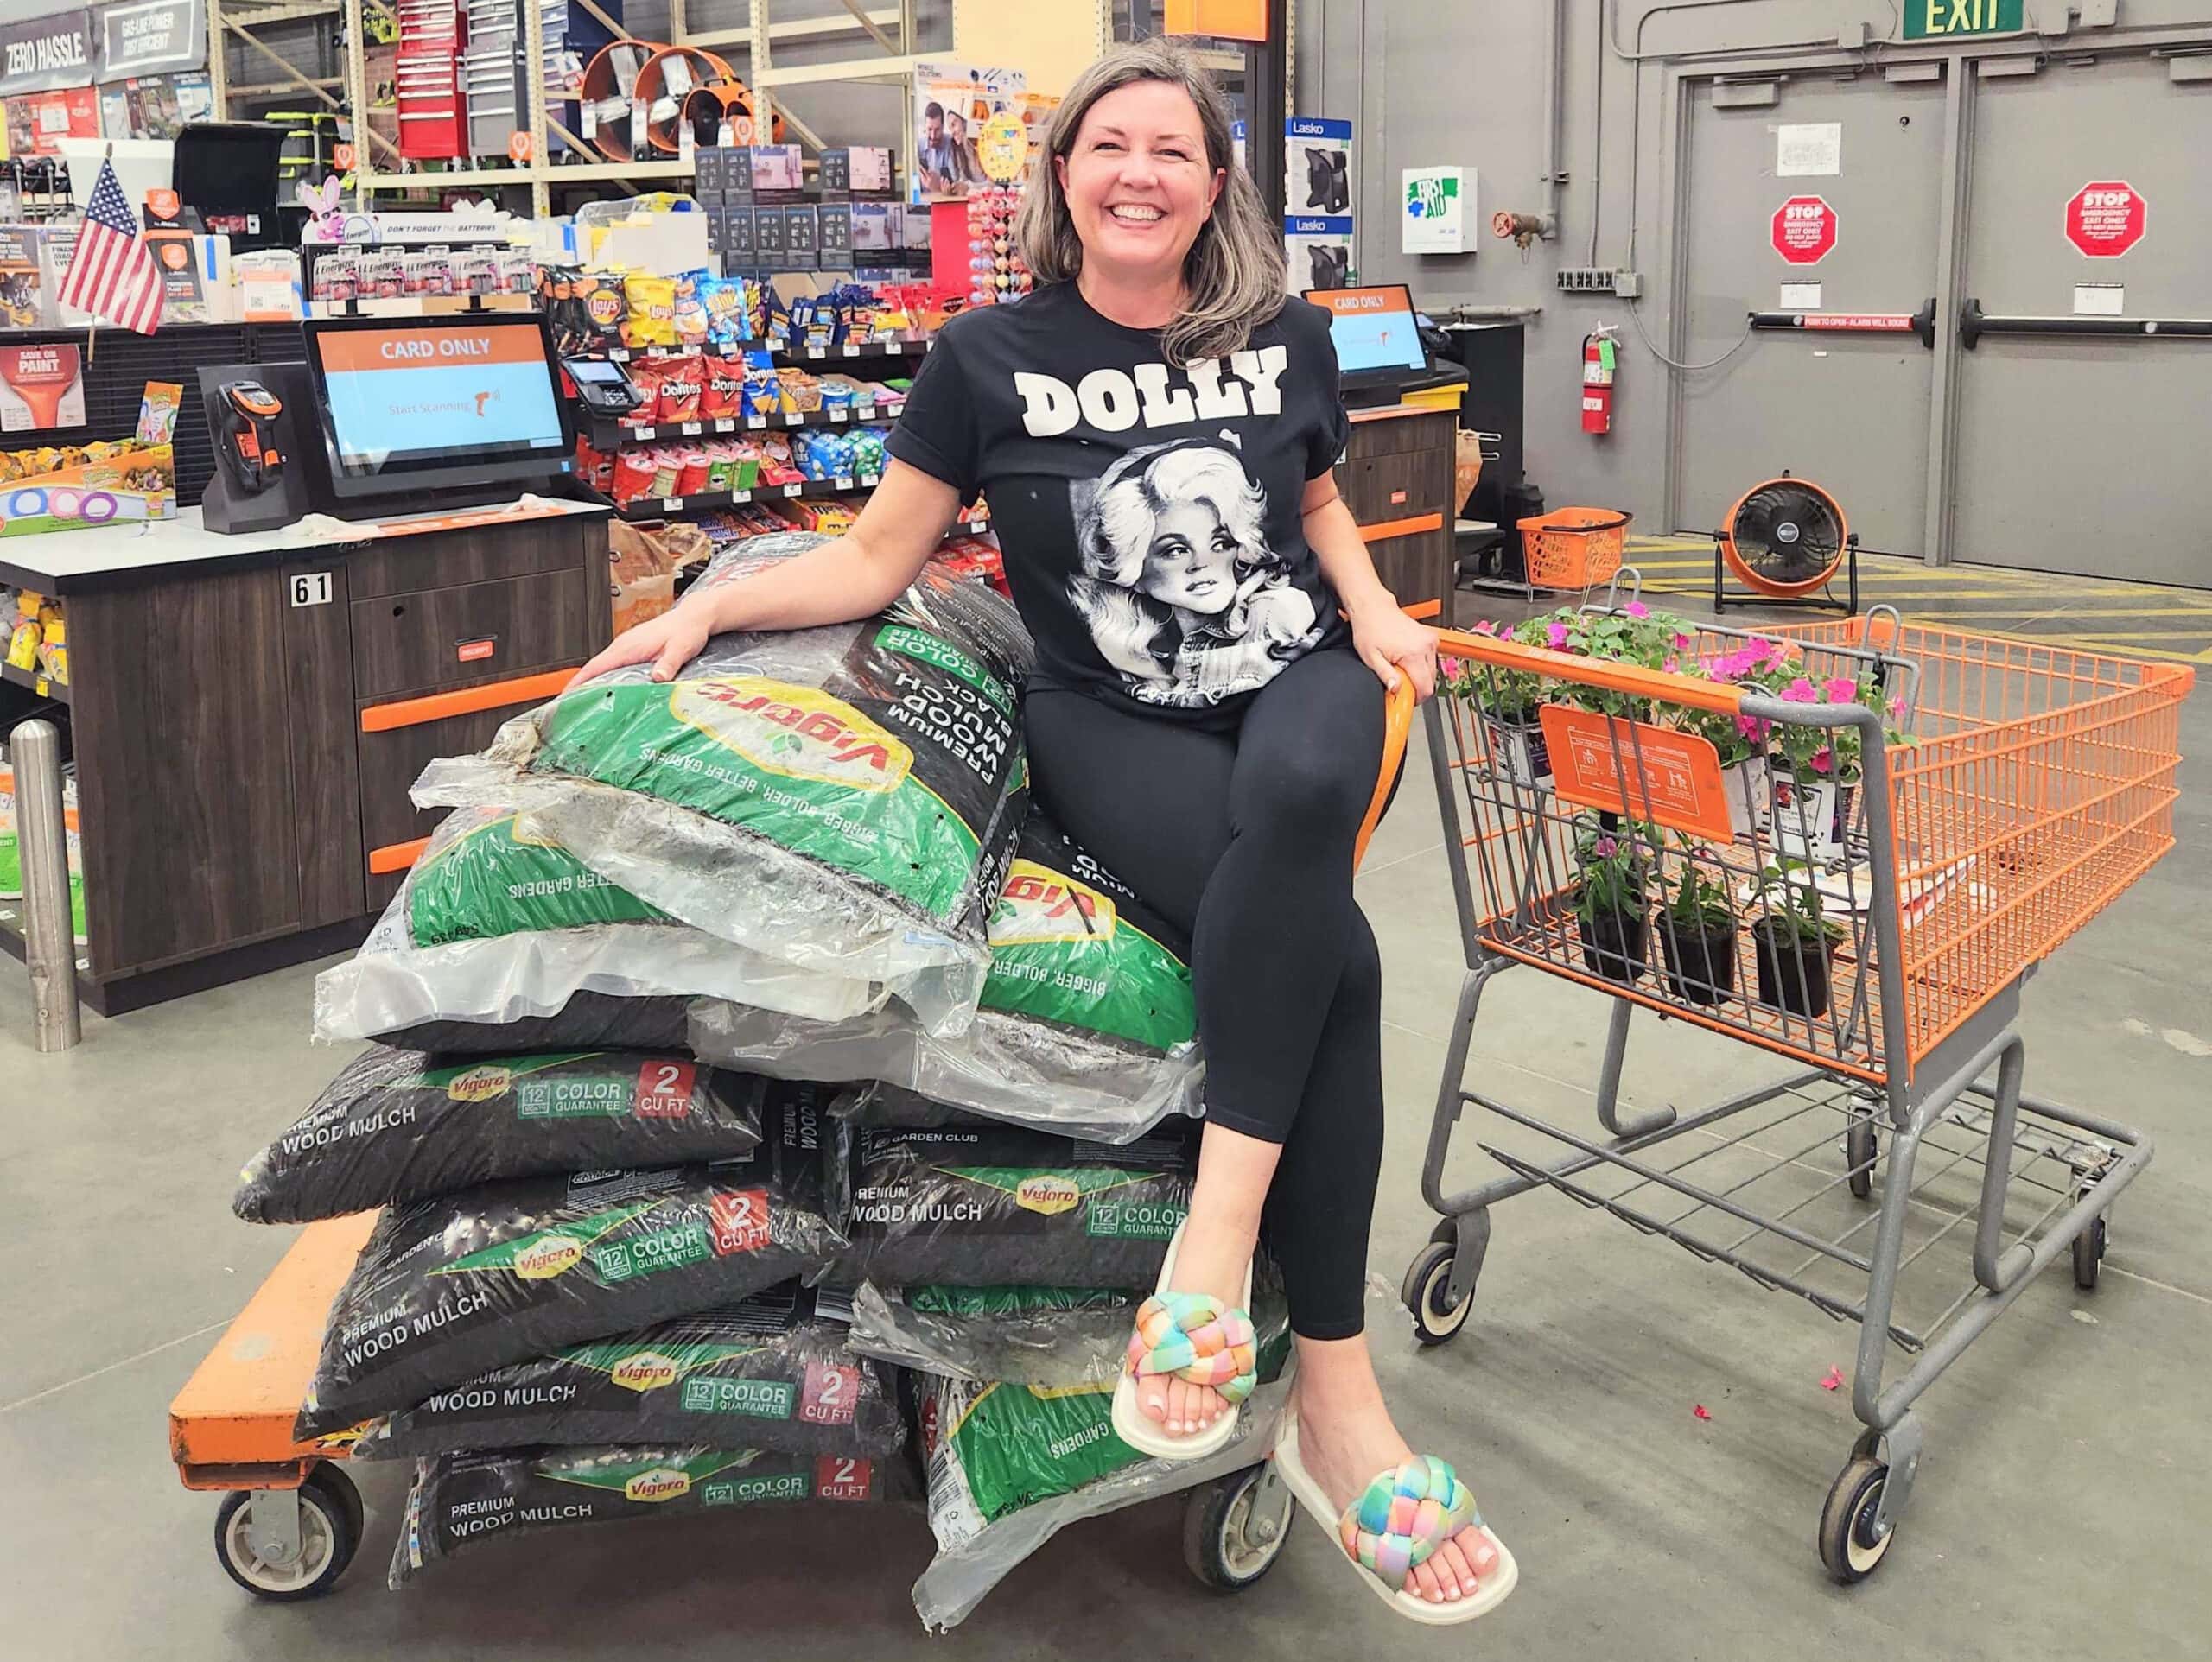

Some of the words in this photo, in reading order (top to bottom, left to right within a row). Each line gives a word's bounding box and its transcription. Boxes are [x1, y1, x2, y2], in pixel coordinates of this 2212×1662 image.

[1926, 0, 1998, 34] EXIT
[6, 40, 35, 76] ZERO
[36, 31, 86, 71] HASSLE.
[1293, 121, 1324, 134] Lasko
[1416, 178, 1444, 200] FIRST
[2083, 193, 2131, 206] STOP
[1425, 195, 1446, 219] AID
[1786, 206, 1824, 219] STOP
[1296, 219, 1325, 231] Lasko
[321, 260, 355, 273] Energizer
[369, 260, 403, 273] Energizer
[415, 260, 448, 271] Energizer
[1334, 297, 1359, 310] CARD
[1360, 295, 1385, 308] ONLY
[20, 351, 43, 360] SAVE
[43, 350, 57, 359] ON
[381, 340, 435, 359] CARD
[439, 338, 490, 357] ONLY
[19, 359, 60, 374] PAINT
[662, 383, 702, 397] Doritos
[1014, 345, 1288, 437] DOLLY
[390, 402, 417, 416] Start
[419, 400, 472, 416] Scanning
[887, 634, 977, 679] COLOR
[891, 629, 979, 671] GUARANTEE
[895, 672, 1007, 756] MULCH
[943, 678, 1013, 739] BLACK
[696, 682, 890, 772] Vigoro
[903, 695, 998, 774] WOOD
[887, 704, 994, 786] PREMIUM
[639, 747, 703, 774] GARDENS
[704, 764, 757, 794] BETTER
[509, 877, 572, 899] GARDENS
[1002, 875, 1096, 918] Vig
[995, 959, 1048, 982] BOLDER
[1054, 968, 1107, 999] BIGGER,
[454, 1075, 505, 1094] Vigoro
[654, 1065, 679, 1094] 2
[527, 1088, 543, 1103] 12
[556, 1082, 621, 1101] COLOR
[556, 1100, 620, 1112] GUARANTEE
[641, 1097, 663, 1112] CU
[667, 1097, 686, 1111] FT
[283, 1125, 344, 1155] WOOD
[349, 1106, 416, 1138] MULCH
[800, 1105, 818, 1150] WOOD
[945, 1133, 978, 1143] CLUB
[1022, 1185, 1075, 1203] Vigoro
[728, 1196, 752, 1230] 2
[912, 1203, 982, 1222] MULCH
[1096, 1208, 1112, 1223] 12
[721, 1232, 743, 1249] CU
[747, 1229, 766, 1242] FT
[1124, 1224, 1175, 1236] GUARANT
[387, 1235, 433, 1270] GARDEN
[632, 1229, 698, 1258] COLOR
[521, 1246, 575, 1272] Vigoro
[605, 1252, 623, 1267] 12
[637, 1246, 702, 1269] GUARANTEE
[343, 1304, 407, 1345] PREMIUM
[345, 1325, 408, 1367] WOOD
[413, 1291, 488, 1336] MULCH
[618, 1365, 671, 1380] Vigoro
[431, 1390, 496, 1413] WOOD
[504, 1384, 577, 1406] MULCH
[691, 1385, 709, 1399] 12
[721, 1385, 787, 1404] COLOR
[819, 1371, 843, 1405] 2
[720, 1400, 786, 1415] GUARANTEE
[805, 1405, 828, 1418] CU
[830, 1410, 852, 1421] FT
[1050, 1421, 1109, 1460] GARDENS
[834, 1457, 855, 1483] 2
[631, 1480, 685, 1496] Vigoro
[709, 1490, 728, 1500] 12
[739, 1477, 803, 1496] COLOR
[822, 1486, 842, 1497] CU
[848, 1485, 866, 1496] FT
[451, 1496, 515, 1518] PREMIUM
[449, 1512, 514, 1538] WOOD
[520, 1504, 593, 1521] MULCH
